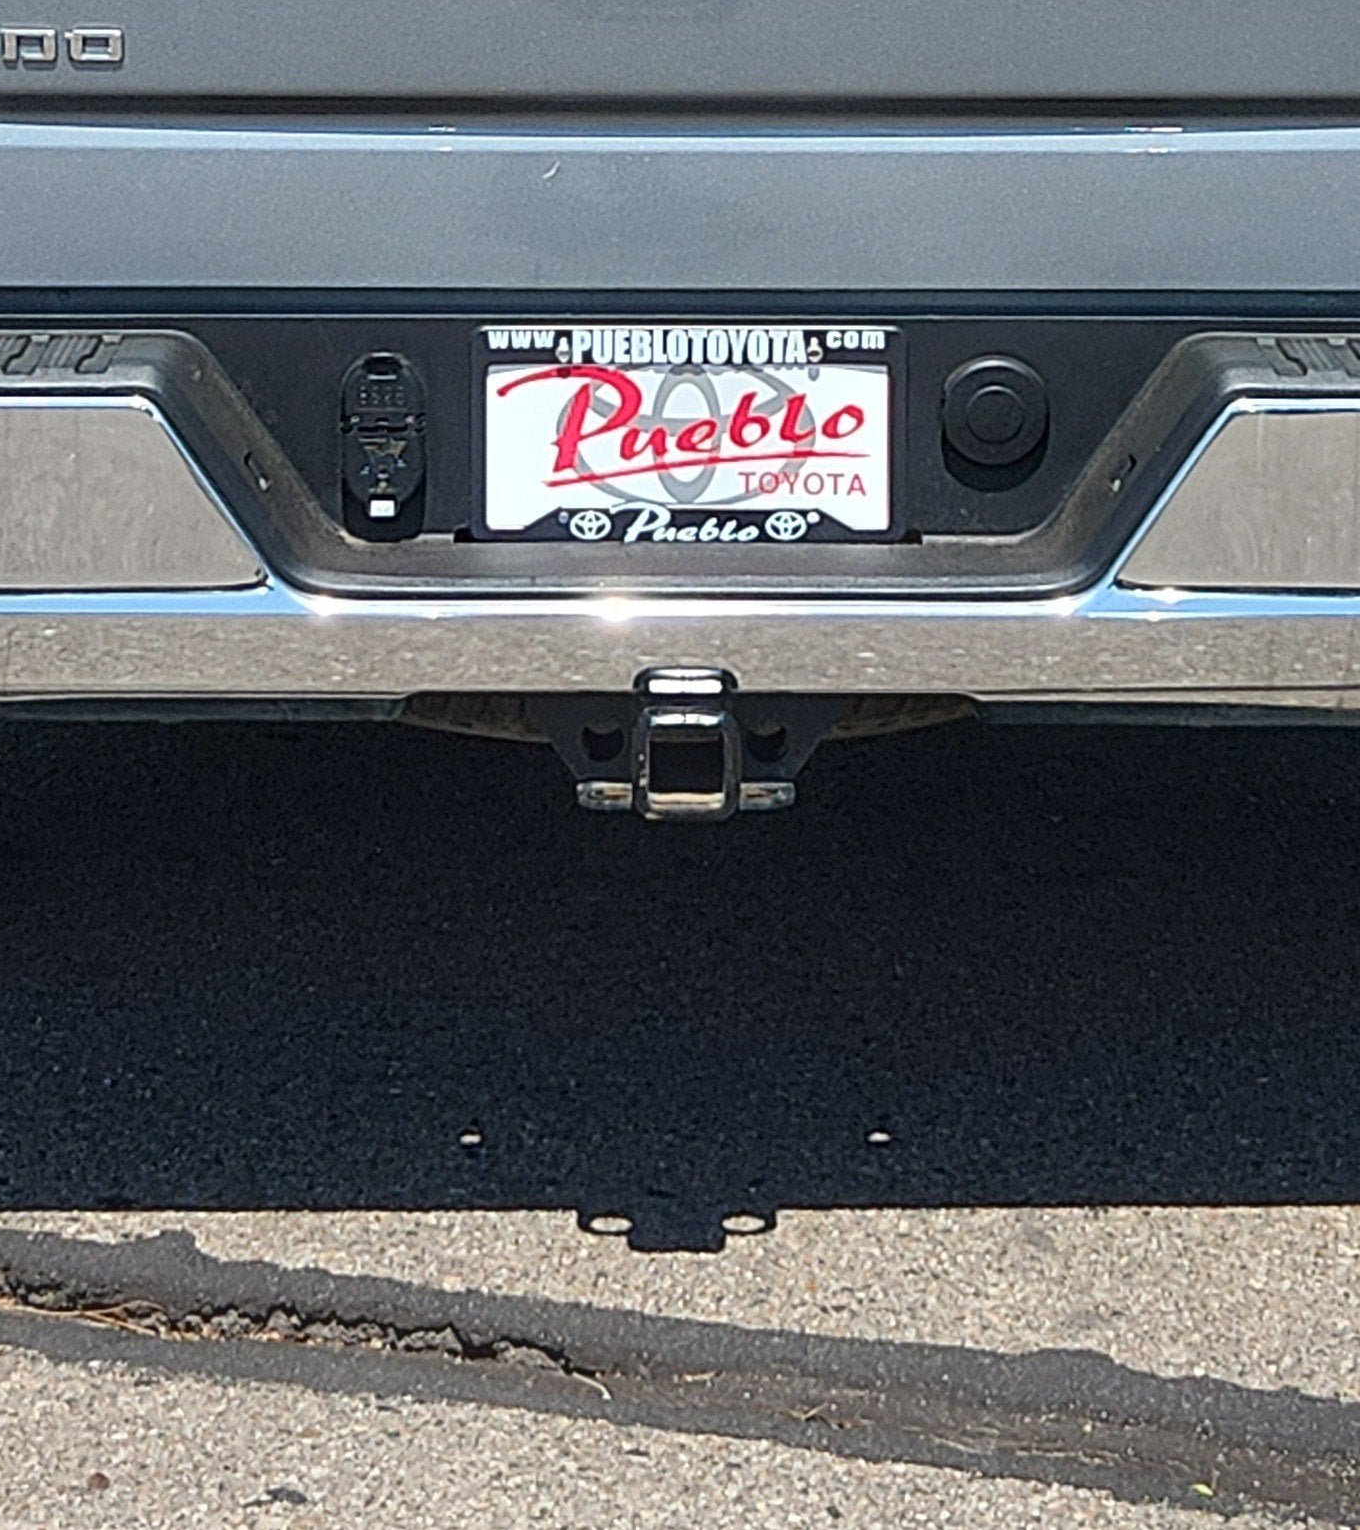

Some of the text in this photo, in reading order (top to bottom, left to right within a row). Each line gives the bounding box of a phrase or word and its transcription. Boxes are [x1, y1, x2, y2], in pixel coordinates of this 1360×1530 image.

[497, 363, 866, 473] Pueblo
[738, 471, 867, 496] TOYOTA
[609, 503, 761, 543] Pueblo
